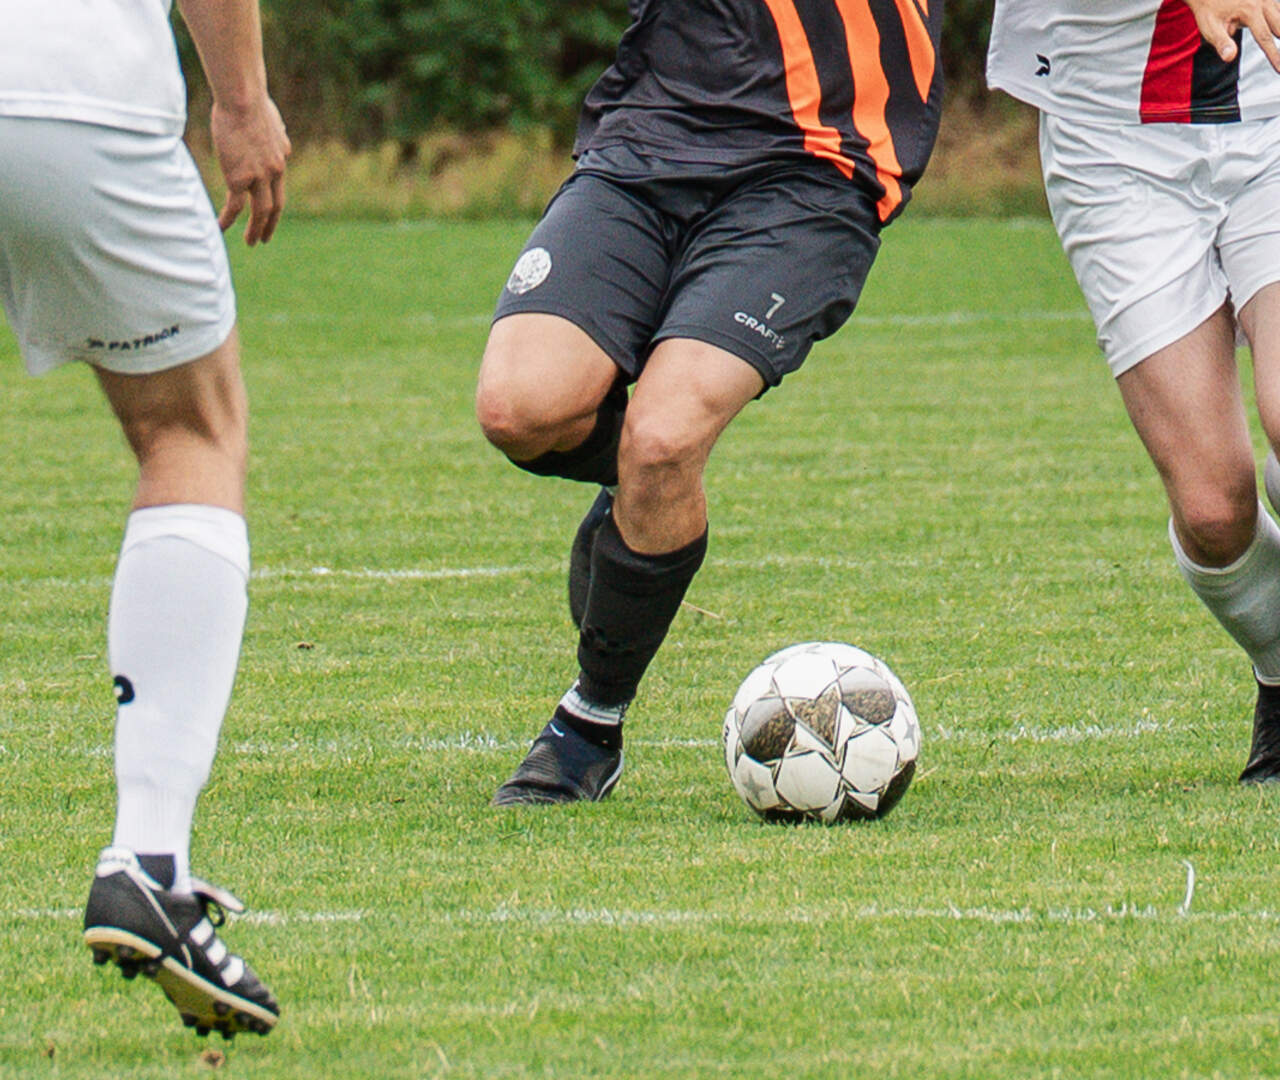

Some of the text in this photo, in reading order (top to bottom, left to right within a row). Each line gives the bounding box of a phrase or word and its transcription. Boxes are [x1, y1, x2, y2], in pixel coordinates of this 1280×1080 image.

[765, 292, 786, 320] 7
[109, 323, 180, 350] PATRICK
[734, 311, 780, 344] CRAFT
